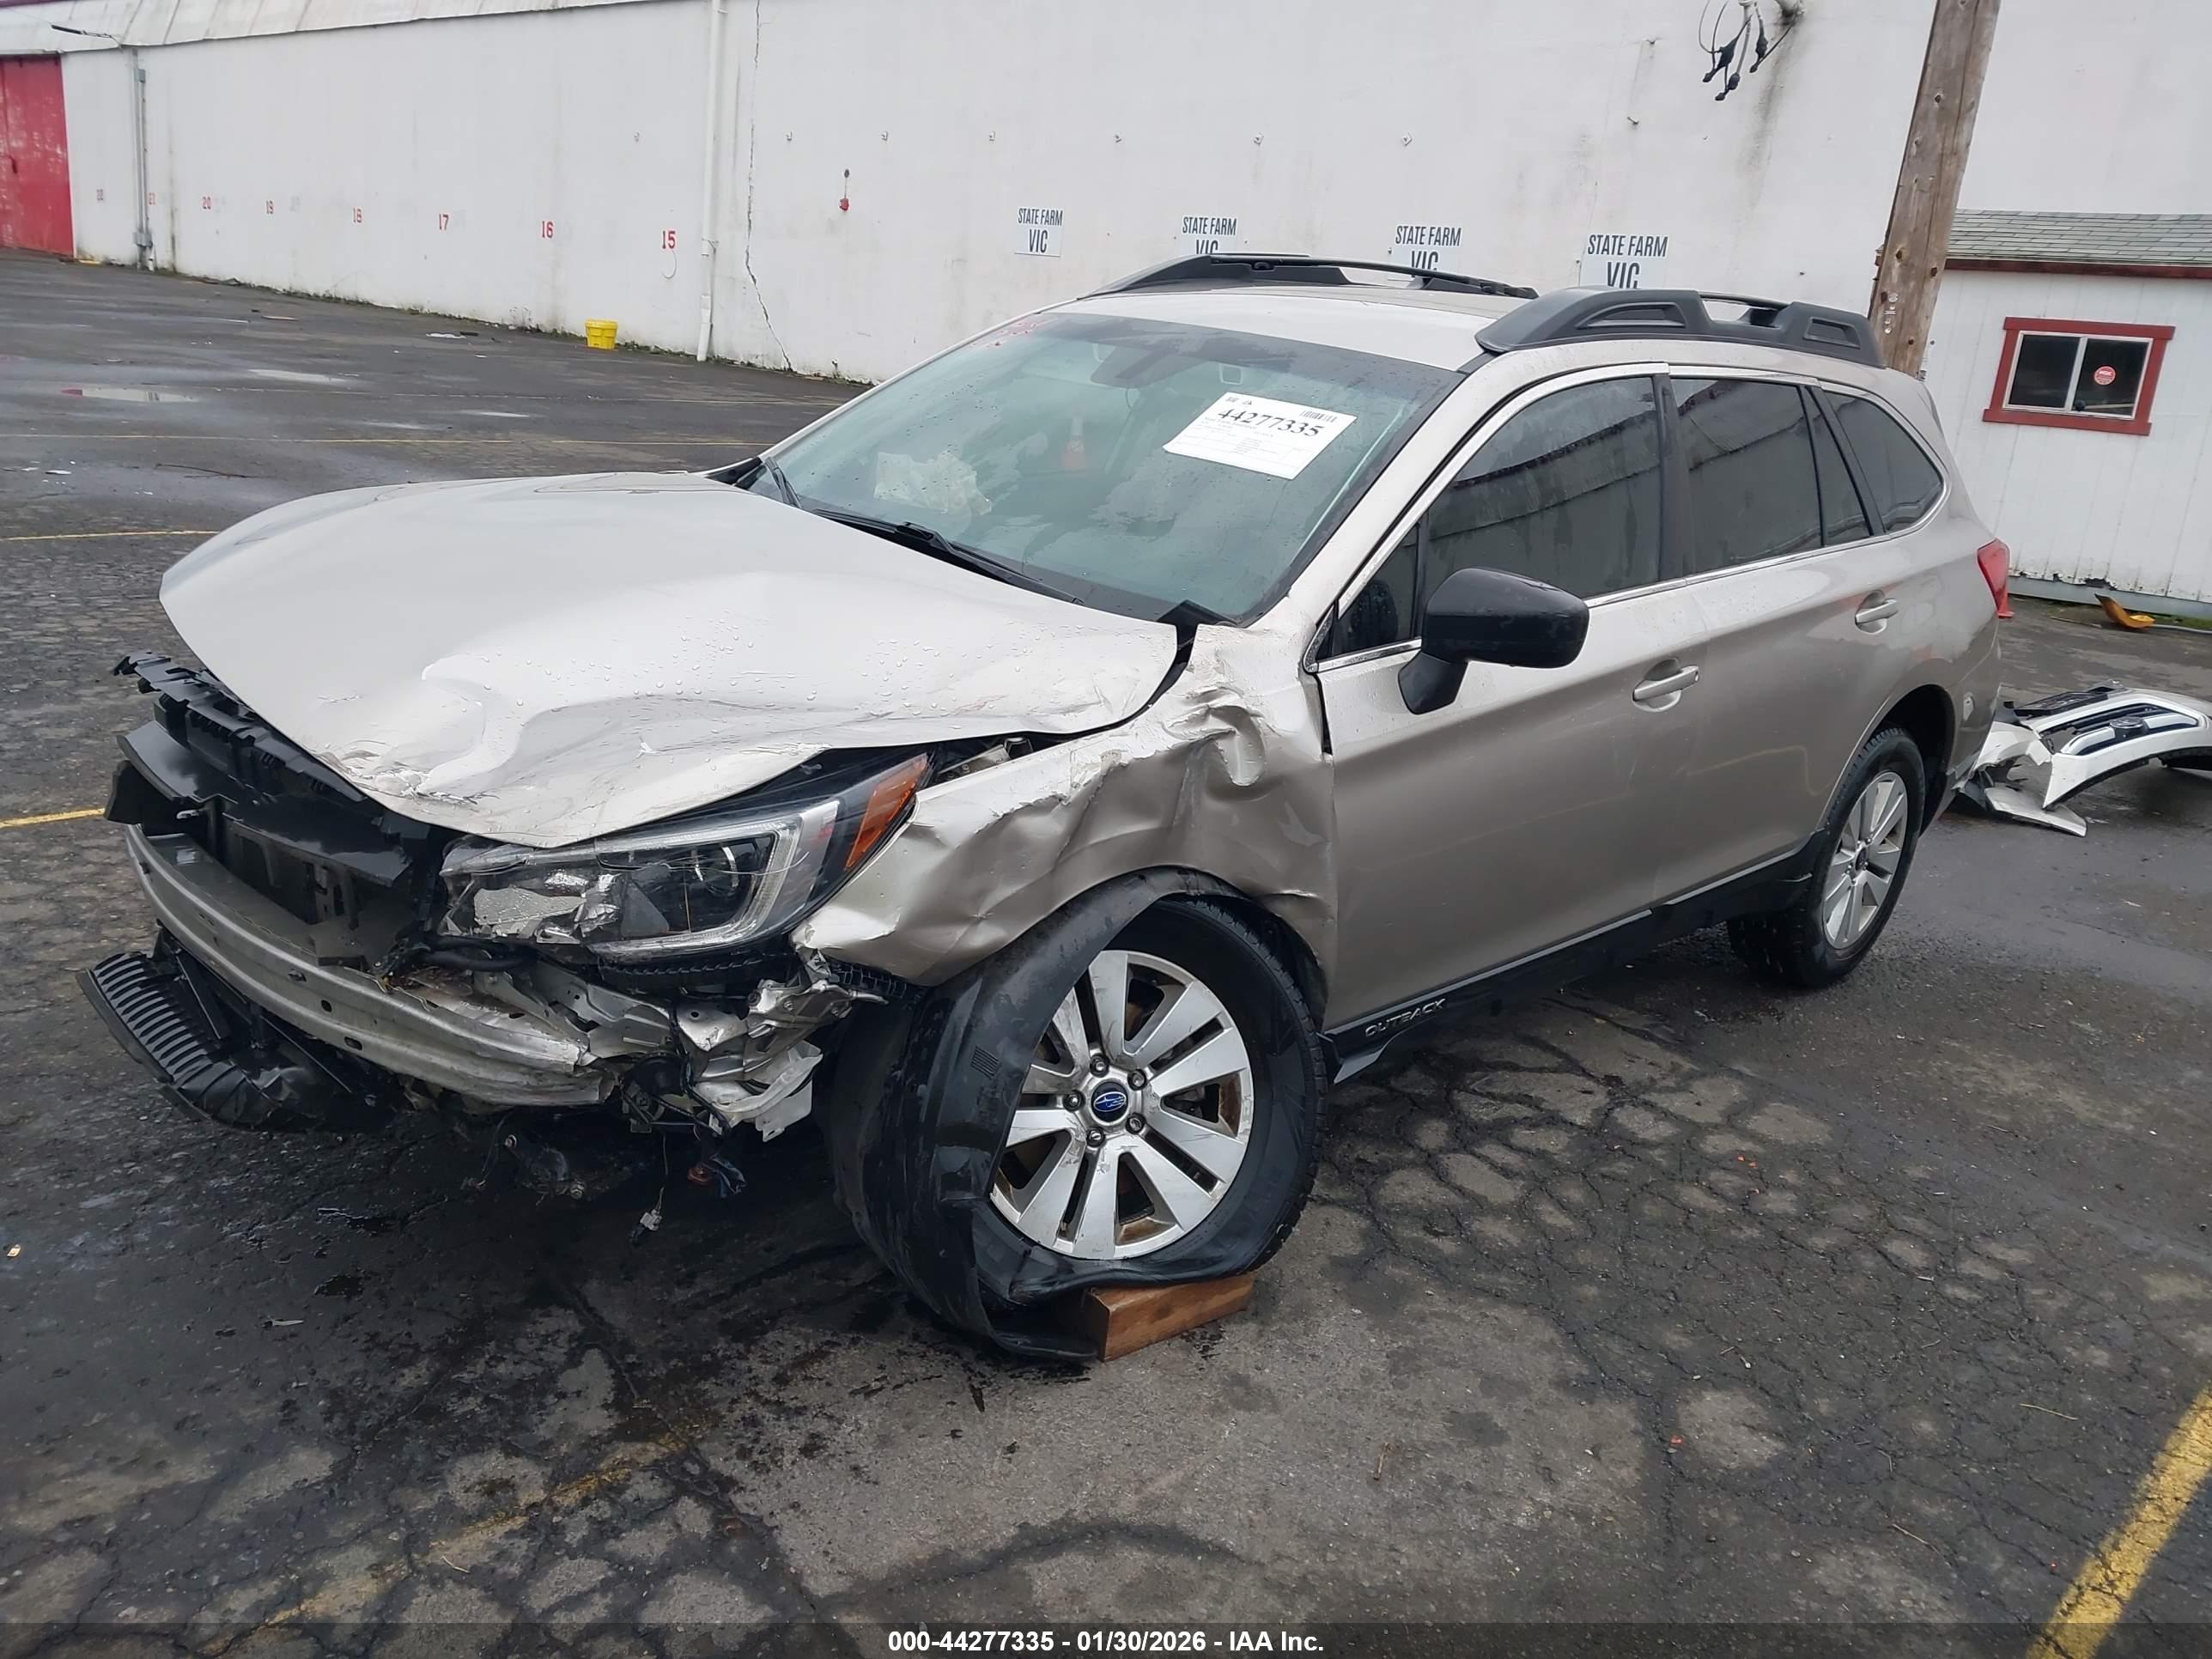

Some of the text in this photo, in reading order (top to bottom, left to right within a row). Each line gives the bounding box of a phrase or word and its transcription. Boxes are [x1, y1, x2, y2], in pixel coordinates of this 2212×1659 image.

[202, 196, 212, 210] 20
[265, 199, 275, 215] 19
[352, 208, 362, 223] 18
[438, 213, 449, 231] 17
[1018, 208, 1064, 227] STATE FARM
[542, 221, 554, 239] 16
[1182, 216, 1237, 236] STATE FARM
[1395, 225, 1462, 247] STATE FARM
[661, 229, 677, 250] 15
[1028, 228, 1048, 253] VIC
[1195, 239, 1218, 254] VIC
[1588, 234, 1668, 258] STATE FARM
[1411, 250, 1439, 273] VIC
[1607, 261, 1641, 289] VIC
[1218, 407, 1325, 437] 44277335
[1364, 998, 1446, 1037] OUTBACK
